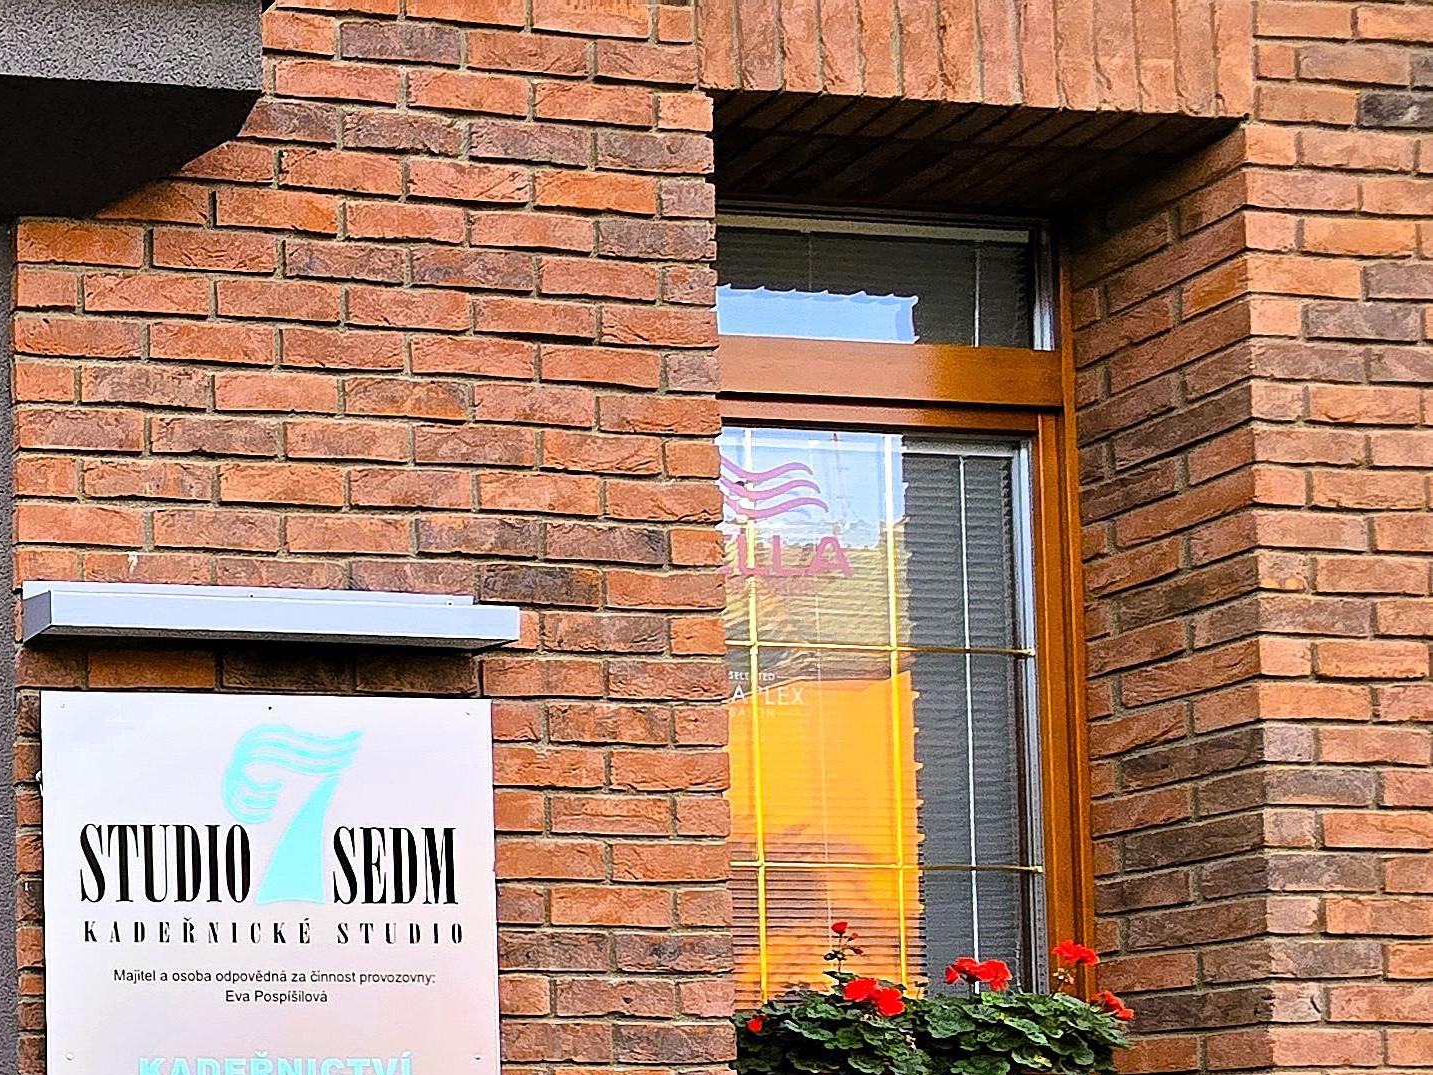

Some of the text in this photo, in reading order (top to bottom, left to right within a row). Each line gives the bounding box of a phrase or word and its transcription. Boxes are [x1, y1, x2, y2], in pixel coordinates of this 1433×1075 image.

[79, 823, 251, 904] STUDIO
[332, 825, 459, 905] SEDM
[84, 916, 463, 945] KADEŘNICKÉ STUDIO
[113, 968, 436, 987] Majitel a osoba odpovědná za činnost provozovny:
[225, 989, 328, 1005] Eva Pospíšilová
